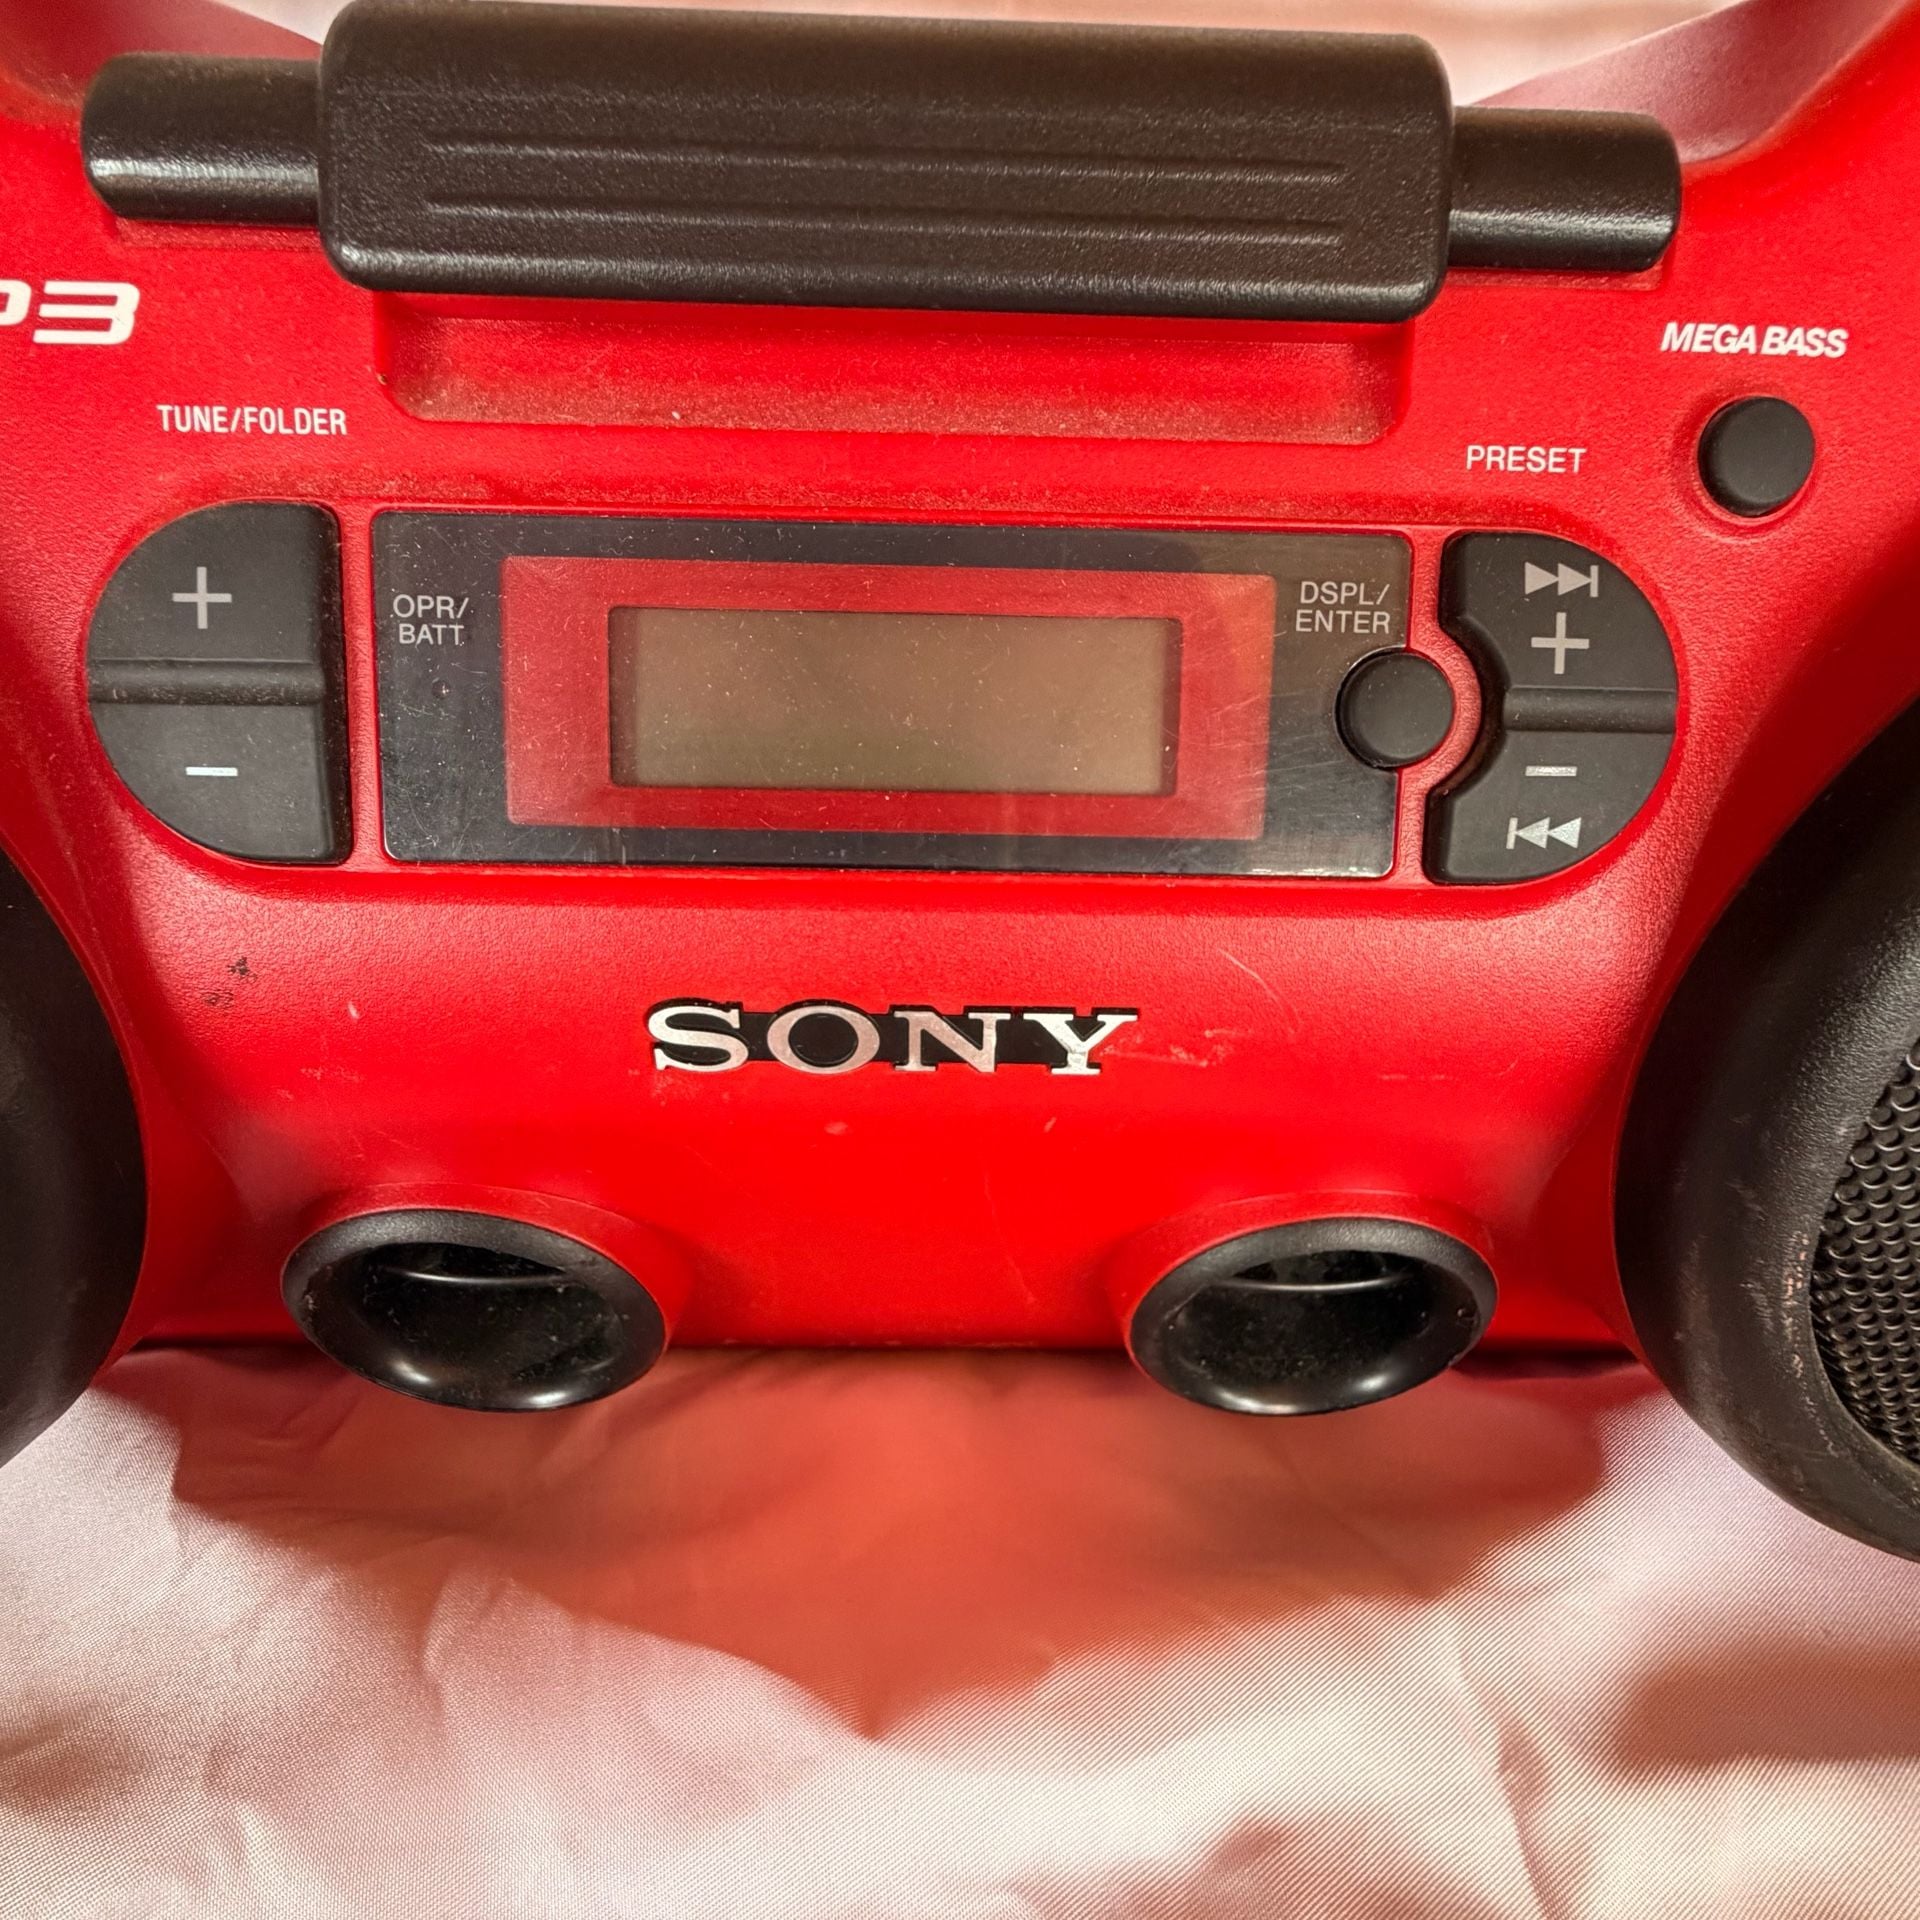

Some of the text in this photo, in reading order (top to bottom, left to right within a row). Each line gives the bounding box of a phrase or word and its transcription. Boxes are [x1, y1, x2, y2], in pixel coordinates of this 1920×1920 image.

[1660, 321, 1849, 359] MEGA BASS
[156, 404, 348, 436] TUNE/FOLDER
[1466, 444, 1587, 474] PRESET
[393, 593, 470, 619] OPR/
[1300, 581, 1390, 606] DSPL/
[398, 622, 465, 646] BATT
[1295, 608, 1391, 635] ENTER
[646, 998, 1139, 1077] SONY
